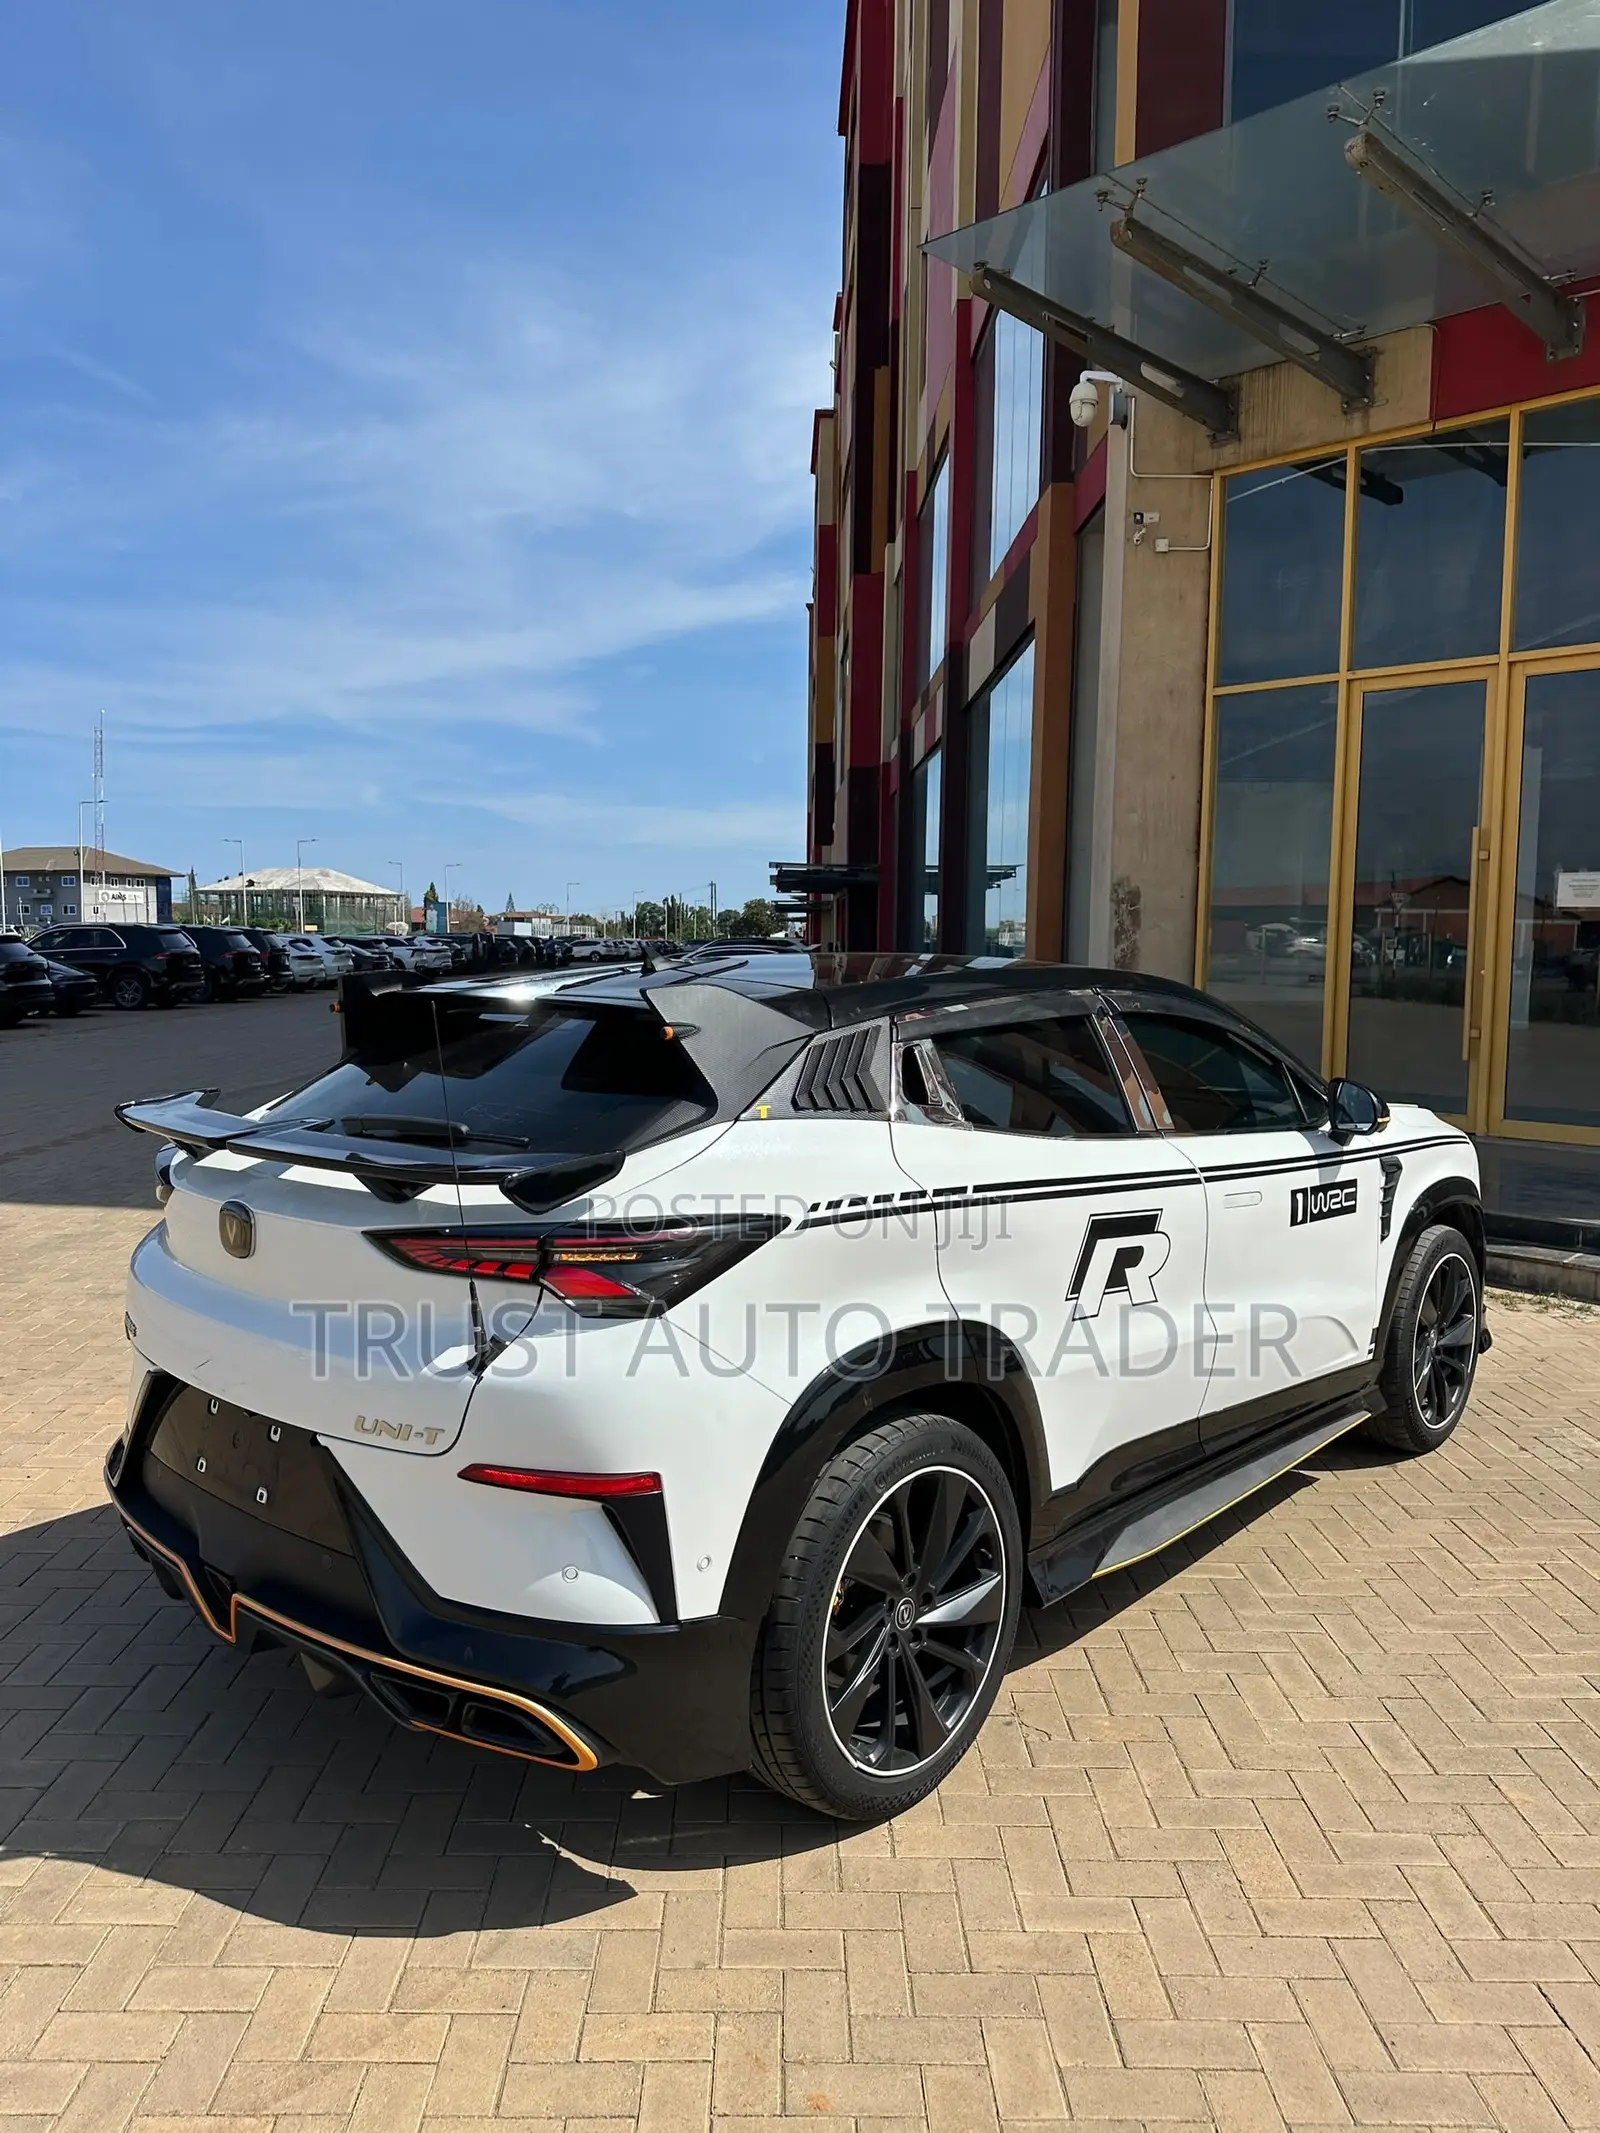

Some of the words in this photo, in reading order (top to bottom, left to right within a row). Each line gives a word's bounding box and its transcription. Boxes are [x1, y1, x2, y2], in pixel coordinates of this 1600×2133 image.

[755, 1105, 771, 1119] T
[1311, 1187, 1357, 1214] WRC
[1070, 1226, 1172, 1322] R
[354, 1415, 446, 1446] UNI-T
